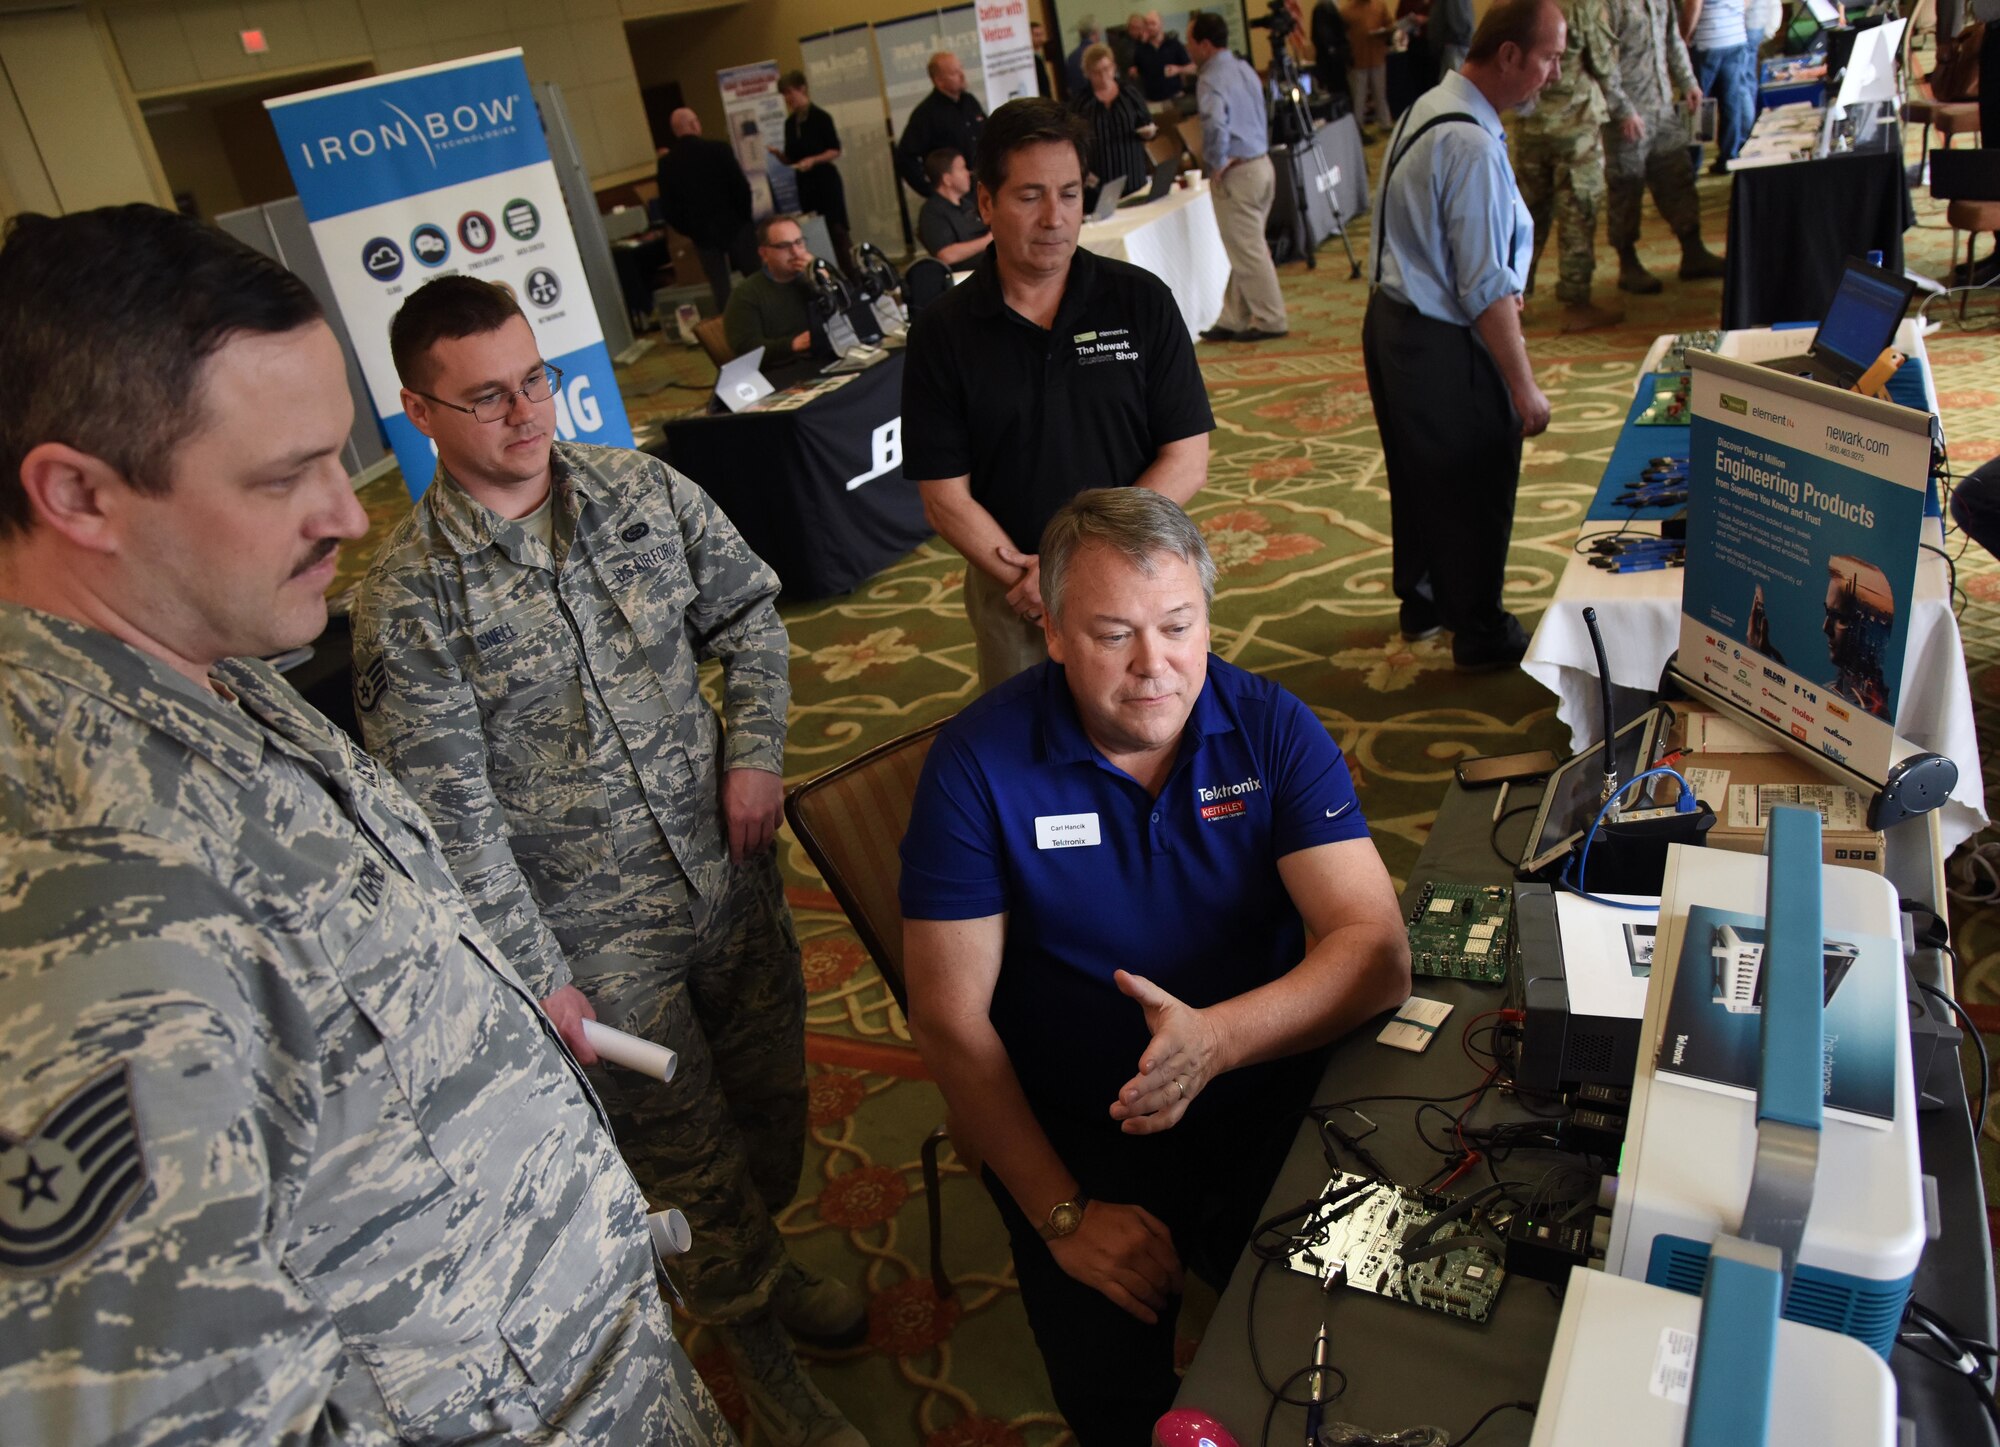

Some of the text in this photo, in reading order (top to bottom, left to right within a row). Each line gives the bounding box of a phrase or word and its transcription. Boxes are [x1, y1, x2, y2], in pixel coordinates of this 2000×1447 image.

[301, 121, 407, 169] IRON
[434, 125, 517, 150] TECHNOLOGIES
[1076, 341, 1130, 356] The Newark
[1079, 351, 1138, 366] Custom Shop
[1718, 436, 1743, 453] Discover
[1744, 446, 1758, 458] Over
[1764, 453, 1785, 469] Million
[1826, 425, 1890, 457] newark.com
[1715, 449, 1875, 529] Engineering Products
[1715, 477, 1822, 526] from Suppliers You Know and Trust
[613, 562, 637, 582] U.S.
[633, 552, 654, 574] AIR
[477, 622, 518, 650] SNELL
[1763, 666, 1786, 685] BELDEN
[1792, 706, 1815, 725] molex
[1823, 726, 1853, 747] multicomp
[1198, 777, 1261, 802] Tektronix
[1202, 801, 1244, 817] KEITHLEY
[1064, 823, 1086, 831] Hancik
[1051, 838, 1086, 847] Tektronix
[1672, 1034, 1689, 1066] Tektronix
[1823, 1034, 1839, 1053] This
